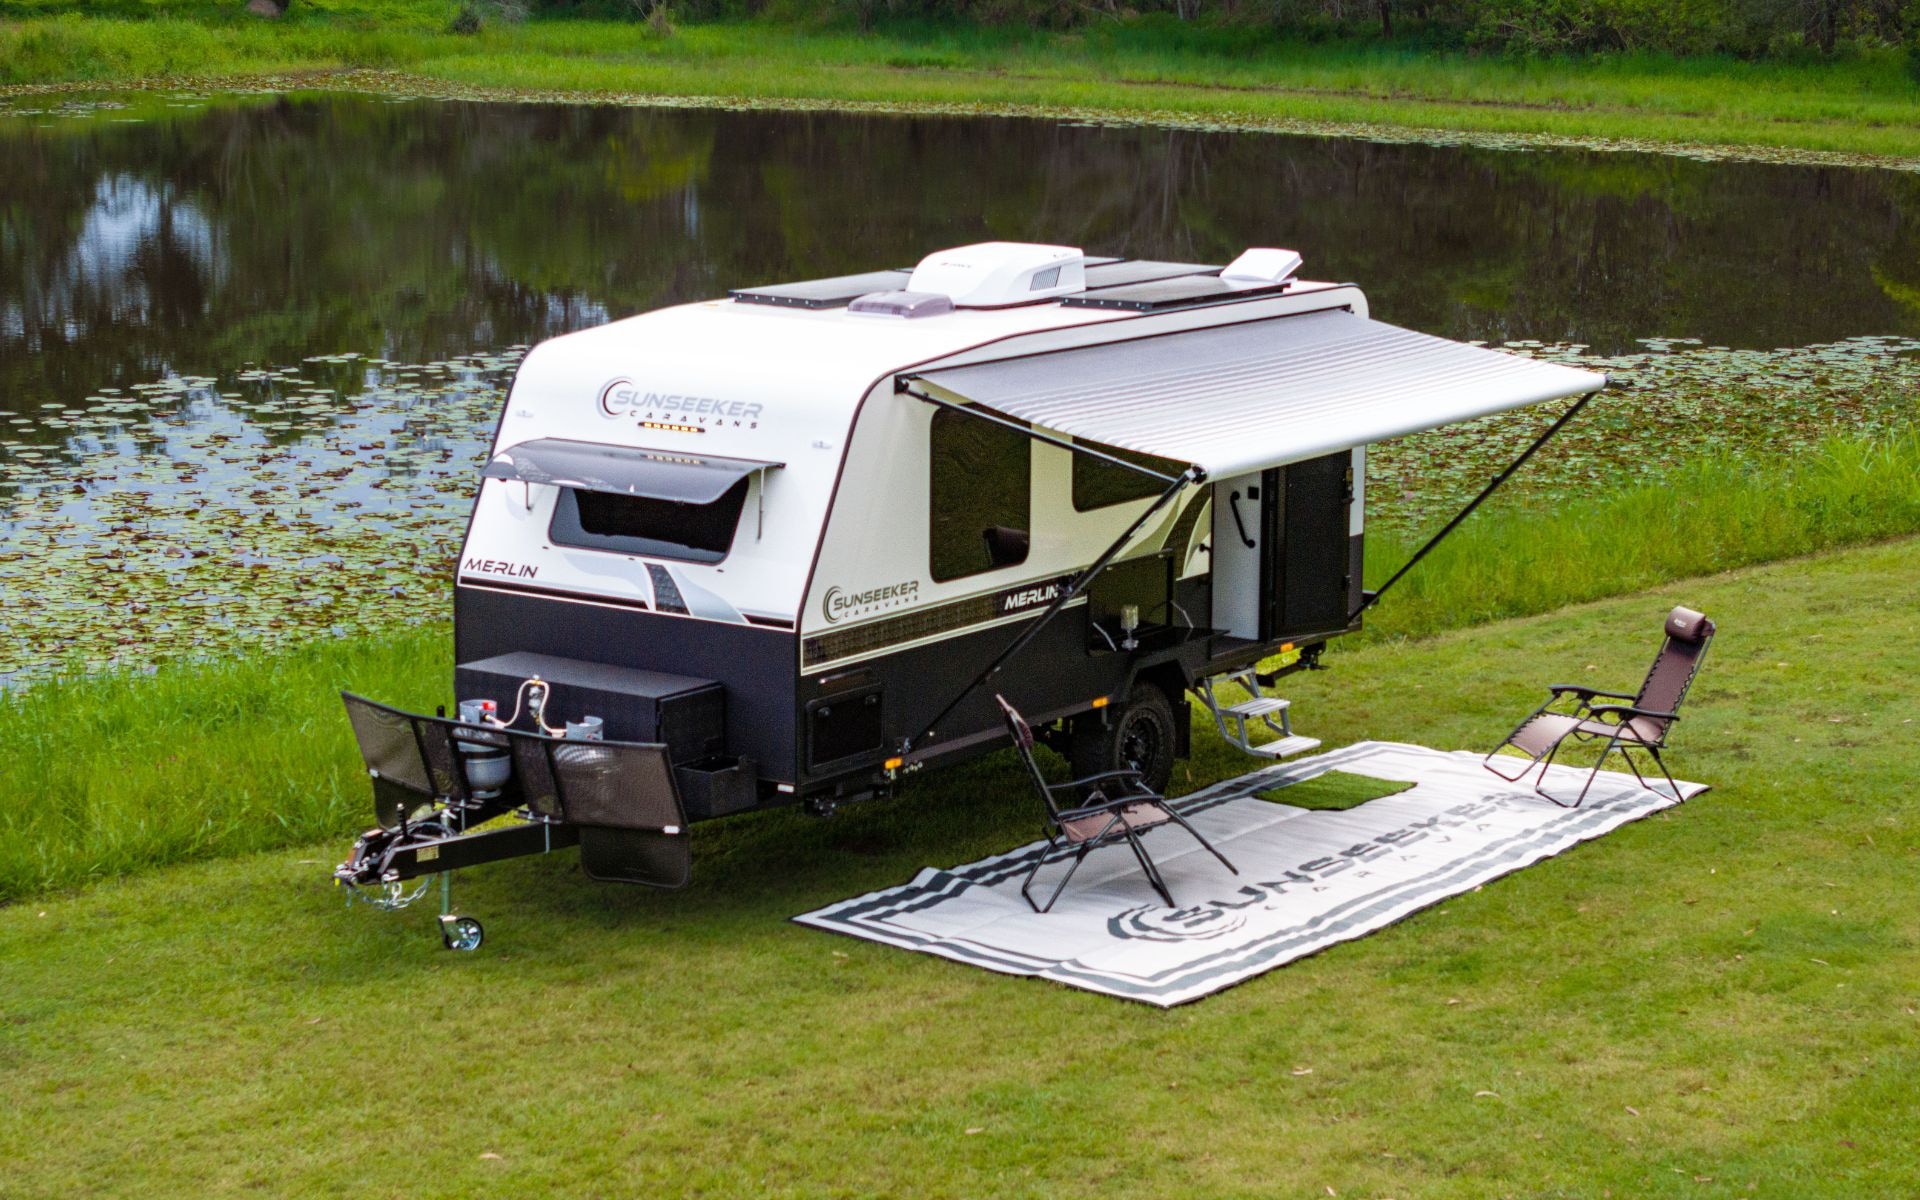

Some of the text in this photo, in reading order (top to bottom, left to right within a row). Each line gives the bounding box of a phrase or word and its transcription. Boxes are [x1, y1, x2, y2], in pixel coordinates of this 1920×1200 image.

[613, 390, 764, 419] SUNSEEKER
[630, 410, 758, 430] CARAVANS
[464, 558, 539, 579] MERLIN
[833, 580, 919, 611] SUNSEEKER
[844, 595, 918, 618] CARAVANS
[1004, 583, 1060, 611] MERLIN
